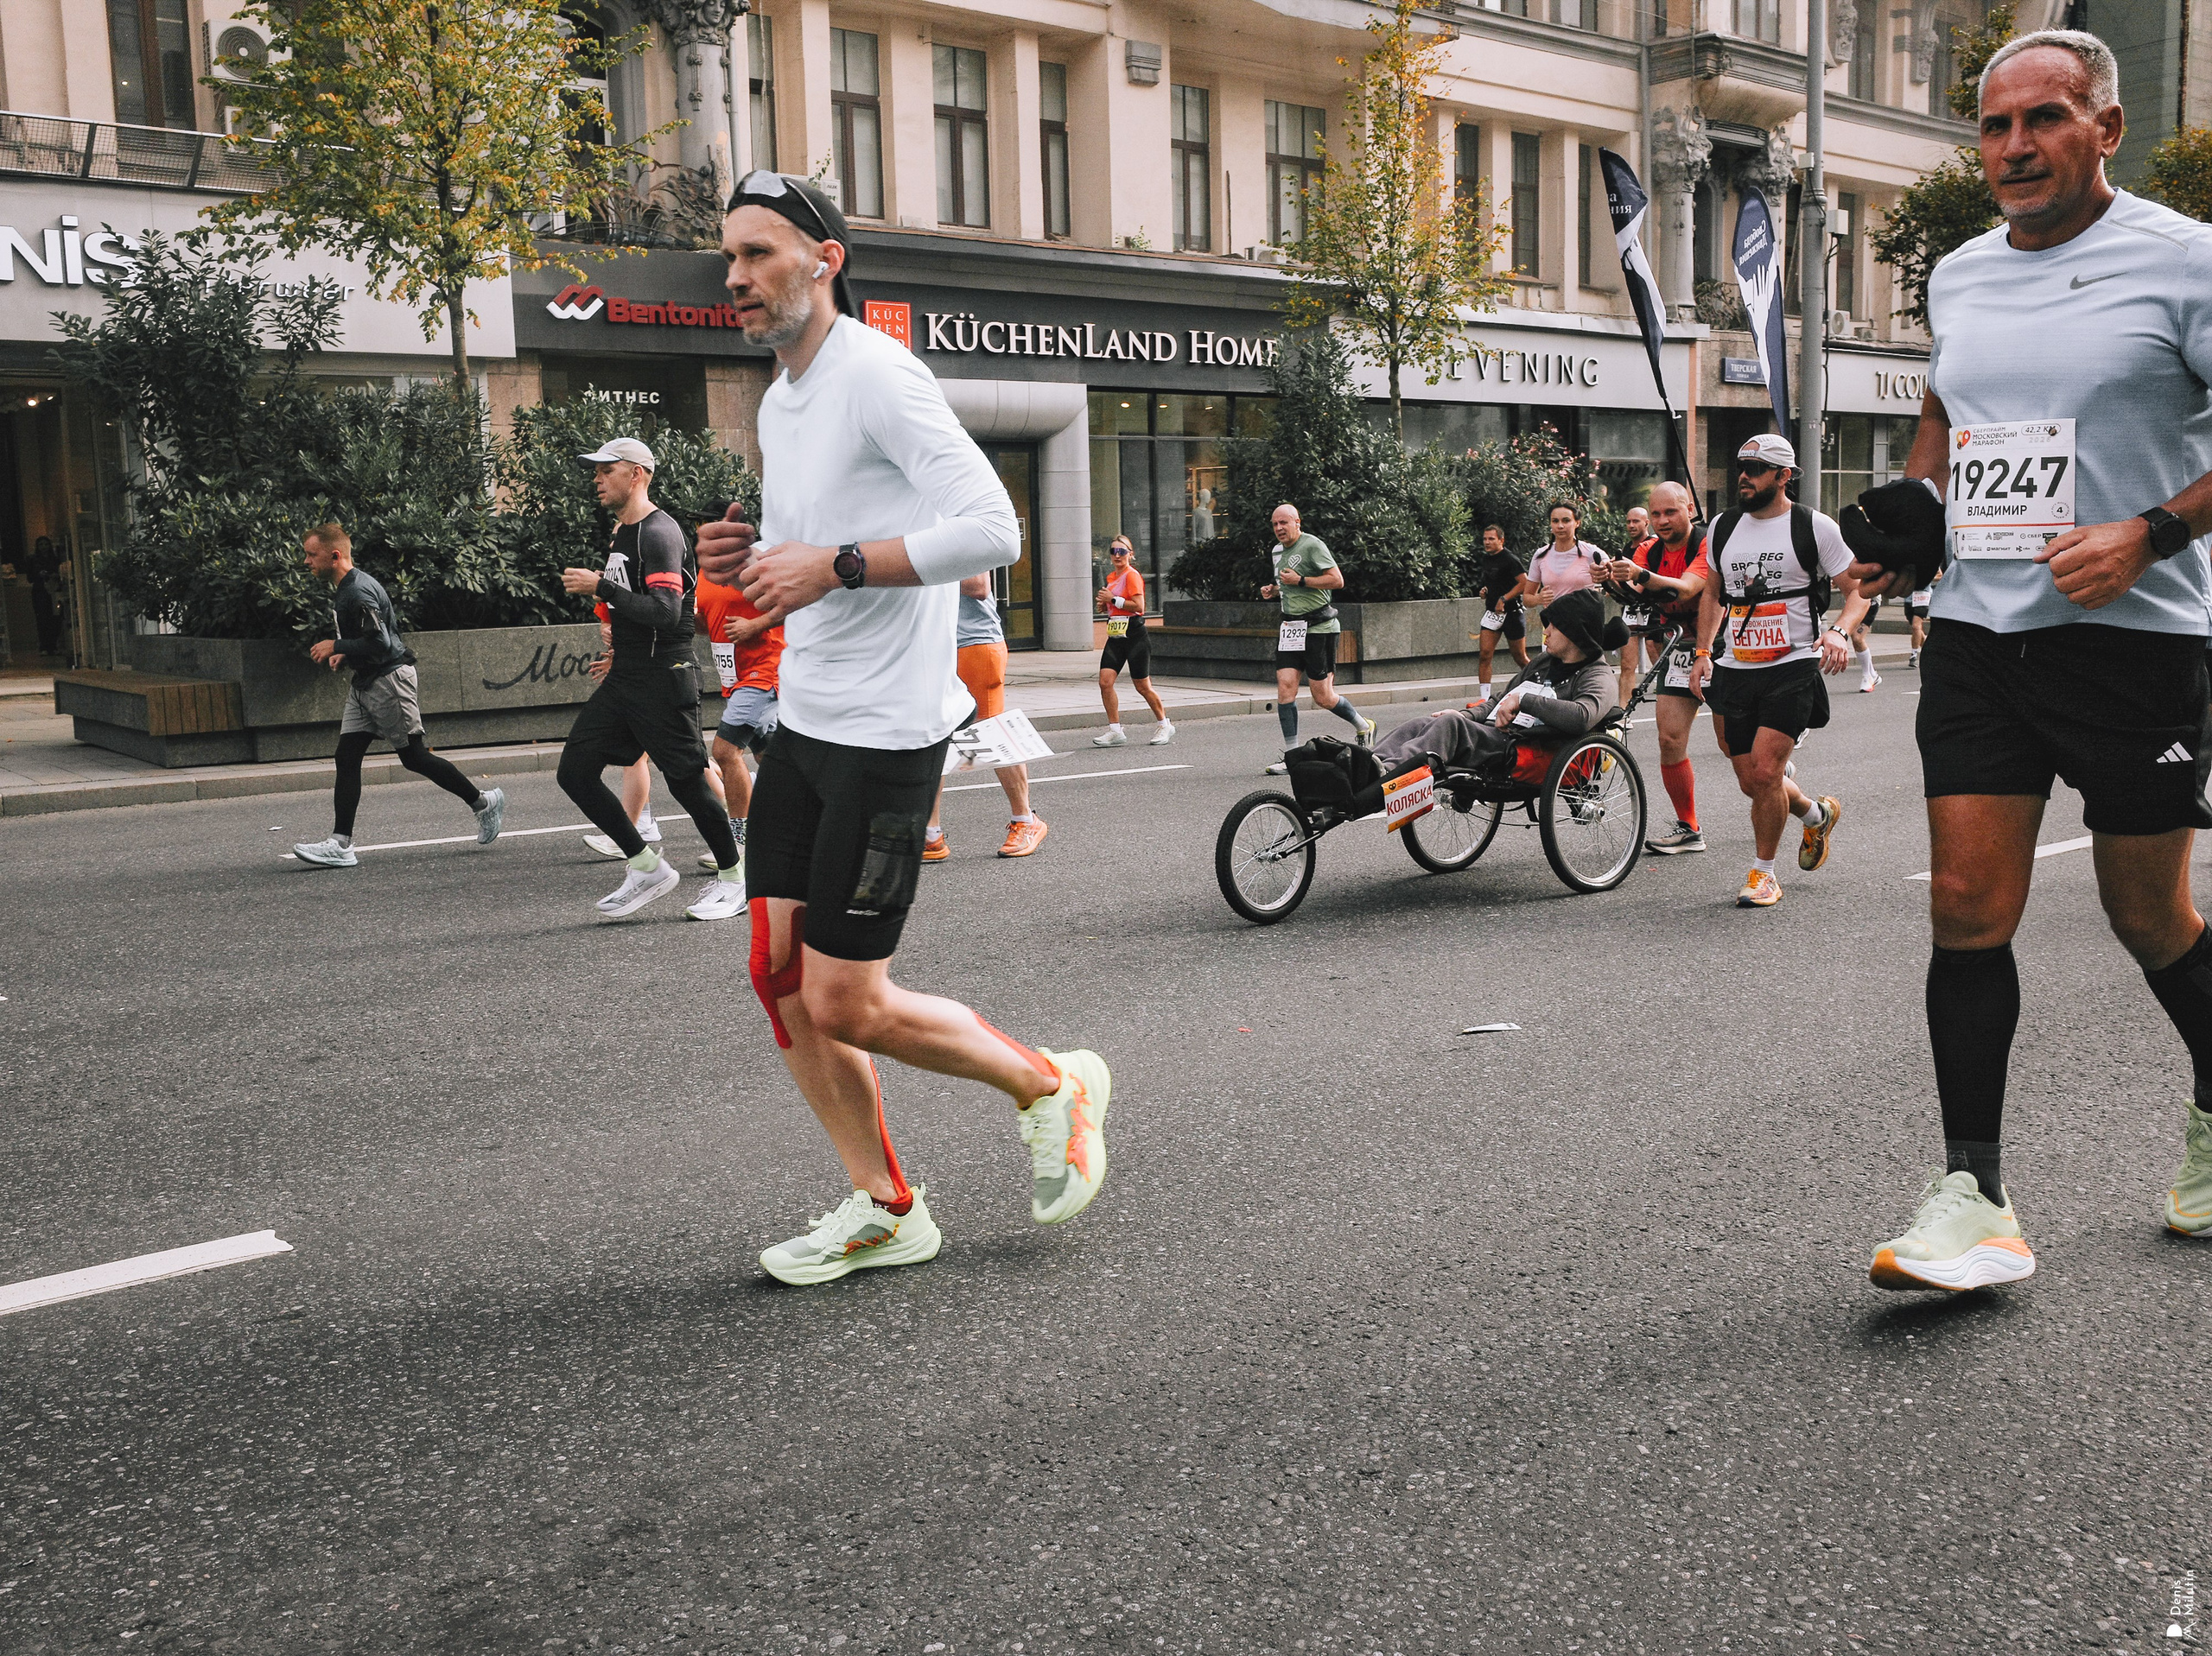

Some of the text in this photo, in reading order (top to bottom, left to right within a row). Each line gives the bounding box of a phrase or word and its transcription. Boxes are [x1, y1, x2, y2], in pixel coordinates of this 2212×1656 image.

[1452, 347, 1599, 386] EVENING
[1731, 364, 1758, 373] ТВЕРСКАЯ
[1876, 371, 1890, 399] TJ
[1972, 431, 2018, 440] МОСКОВСКИЙ
[1952, 456, 2069, 501] 19247
[1967, 504, 2028, 517] ВЛАДИМИР
[1732, 619, 1783, 628] СОПВОЖДЕНИЕ
[1281, 628, 1306, 638] 12932
[1732, 628, 1786, 646] БЕГУНА
[714, 654, 733, 668] 755
[1386, 784, 1433, 816] КОЛЯСКА
